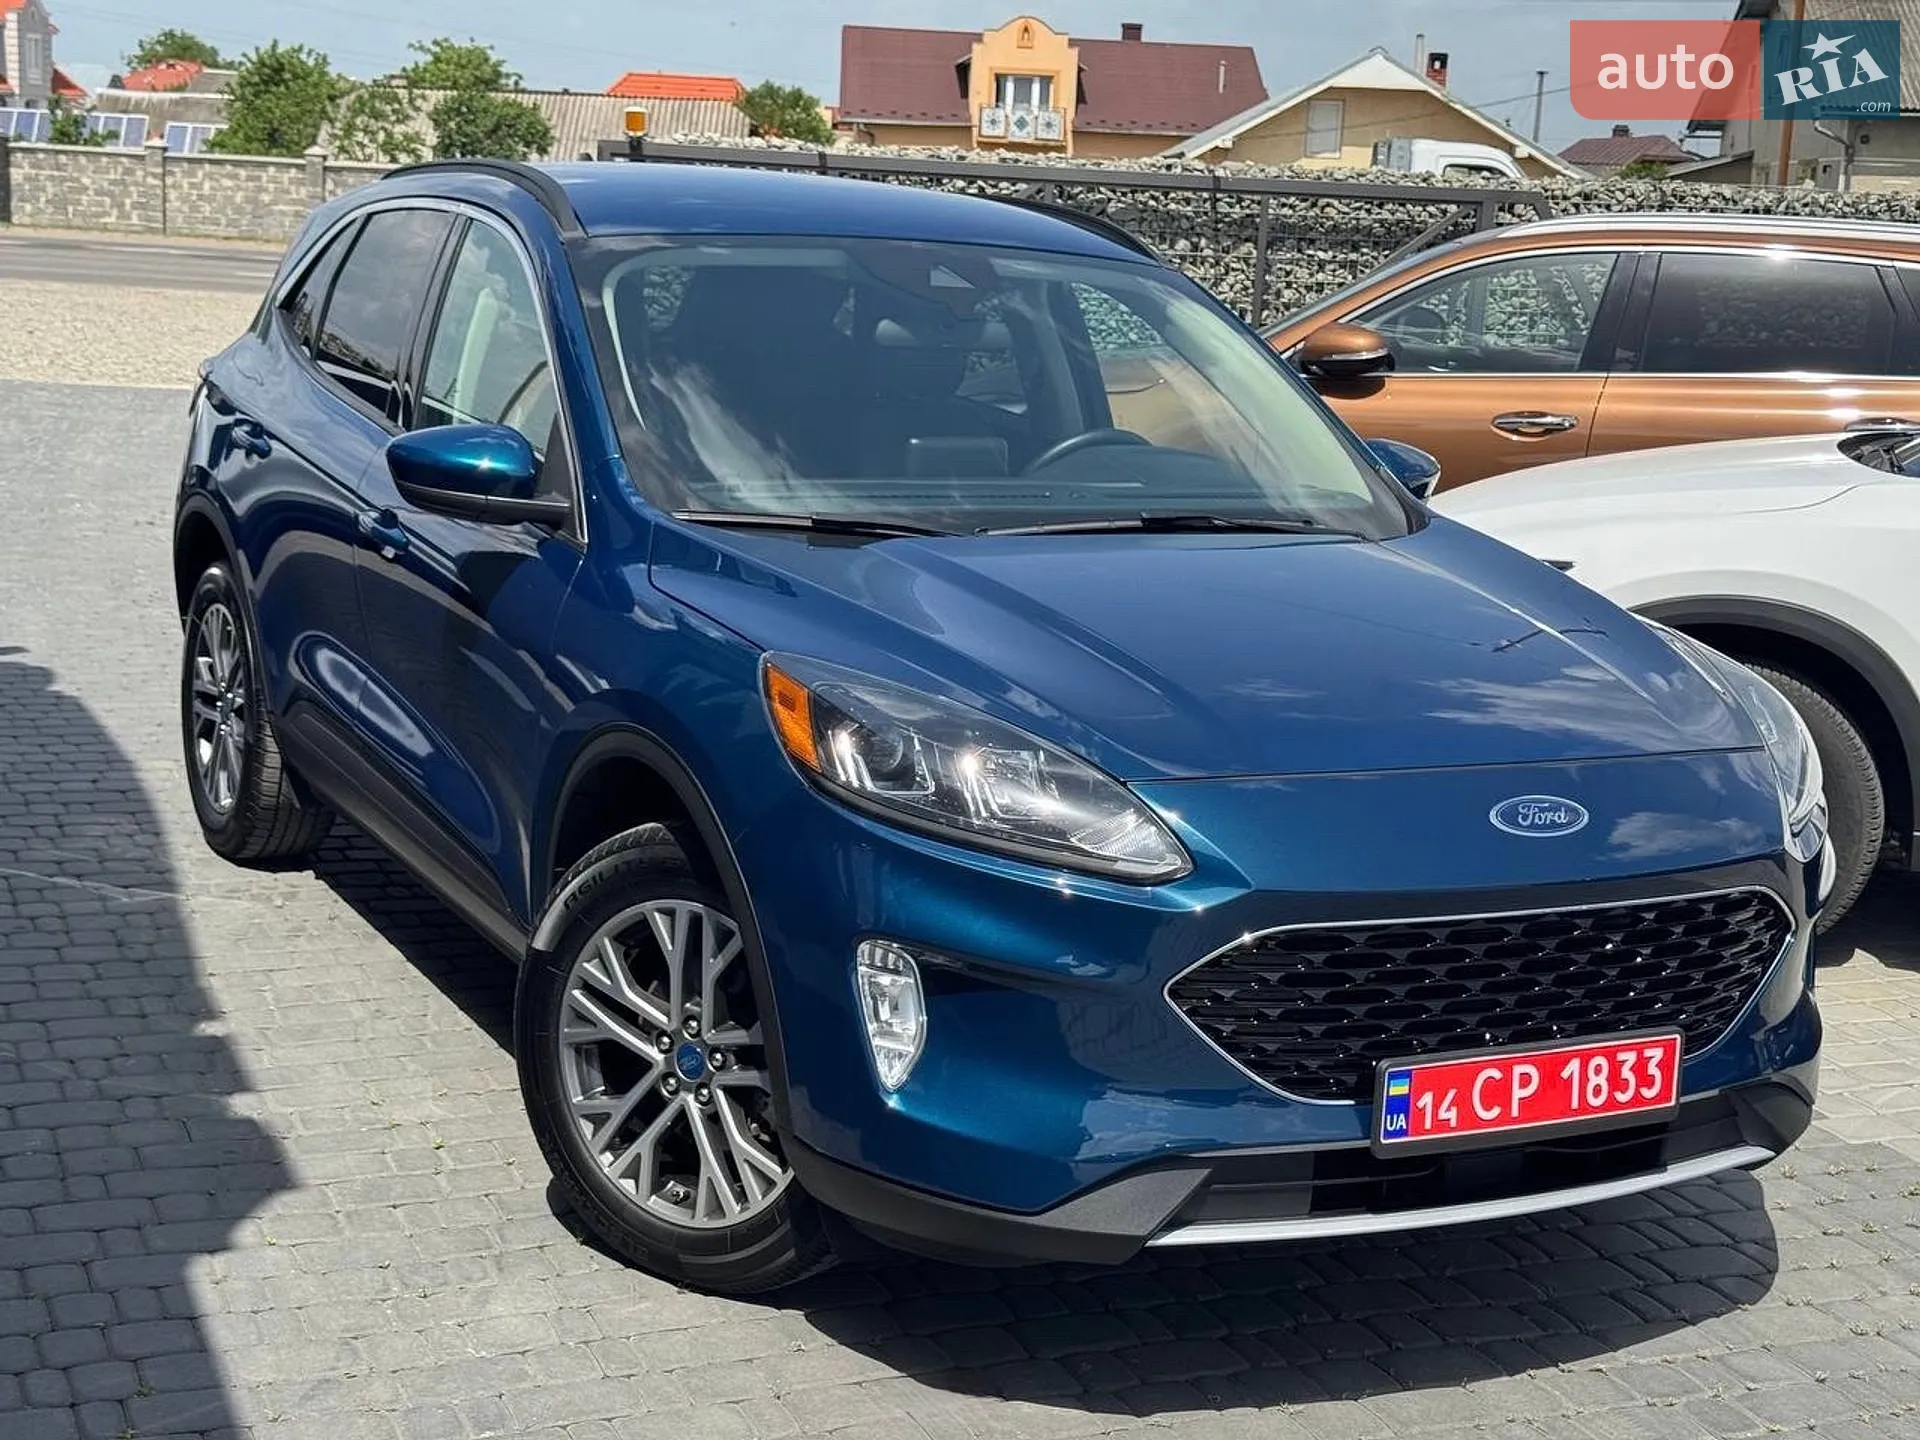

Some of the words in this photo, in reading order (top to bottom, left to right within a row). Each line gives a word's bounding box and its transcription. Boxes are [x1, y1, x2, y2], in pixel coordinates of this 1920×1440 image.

[1518, 803, 1569, 826] Ford
[1416, 1089, 1458, 1130] 14
[1472, 1064, 1540, 1121] CP
[1560, 1047, 1664, 1110] 1833
[1386, 1113, 1407, 1132] UA
